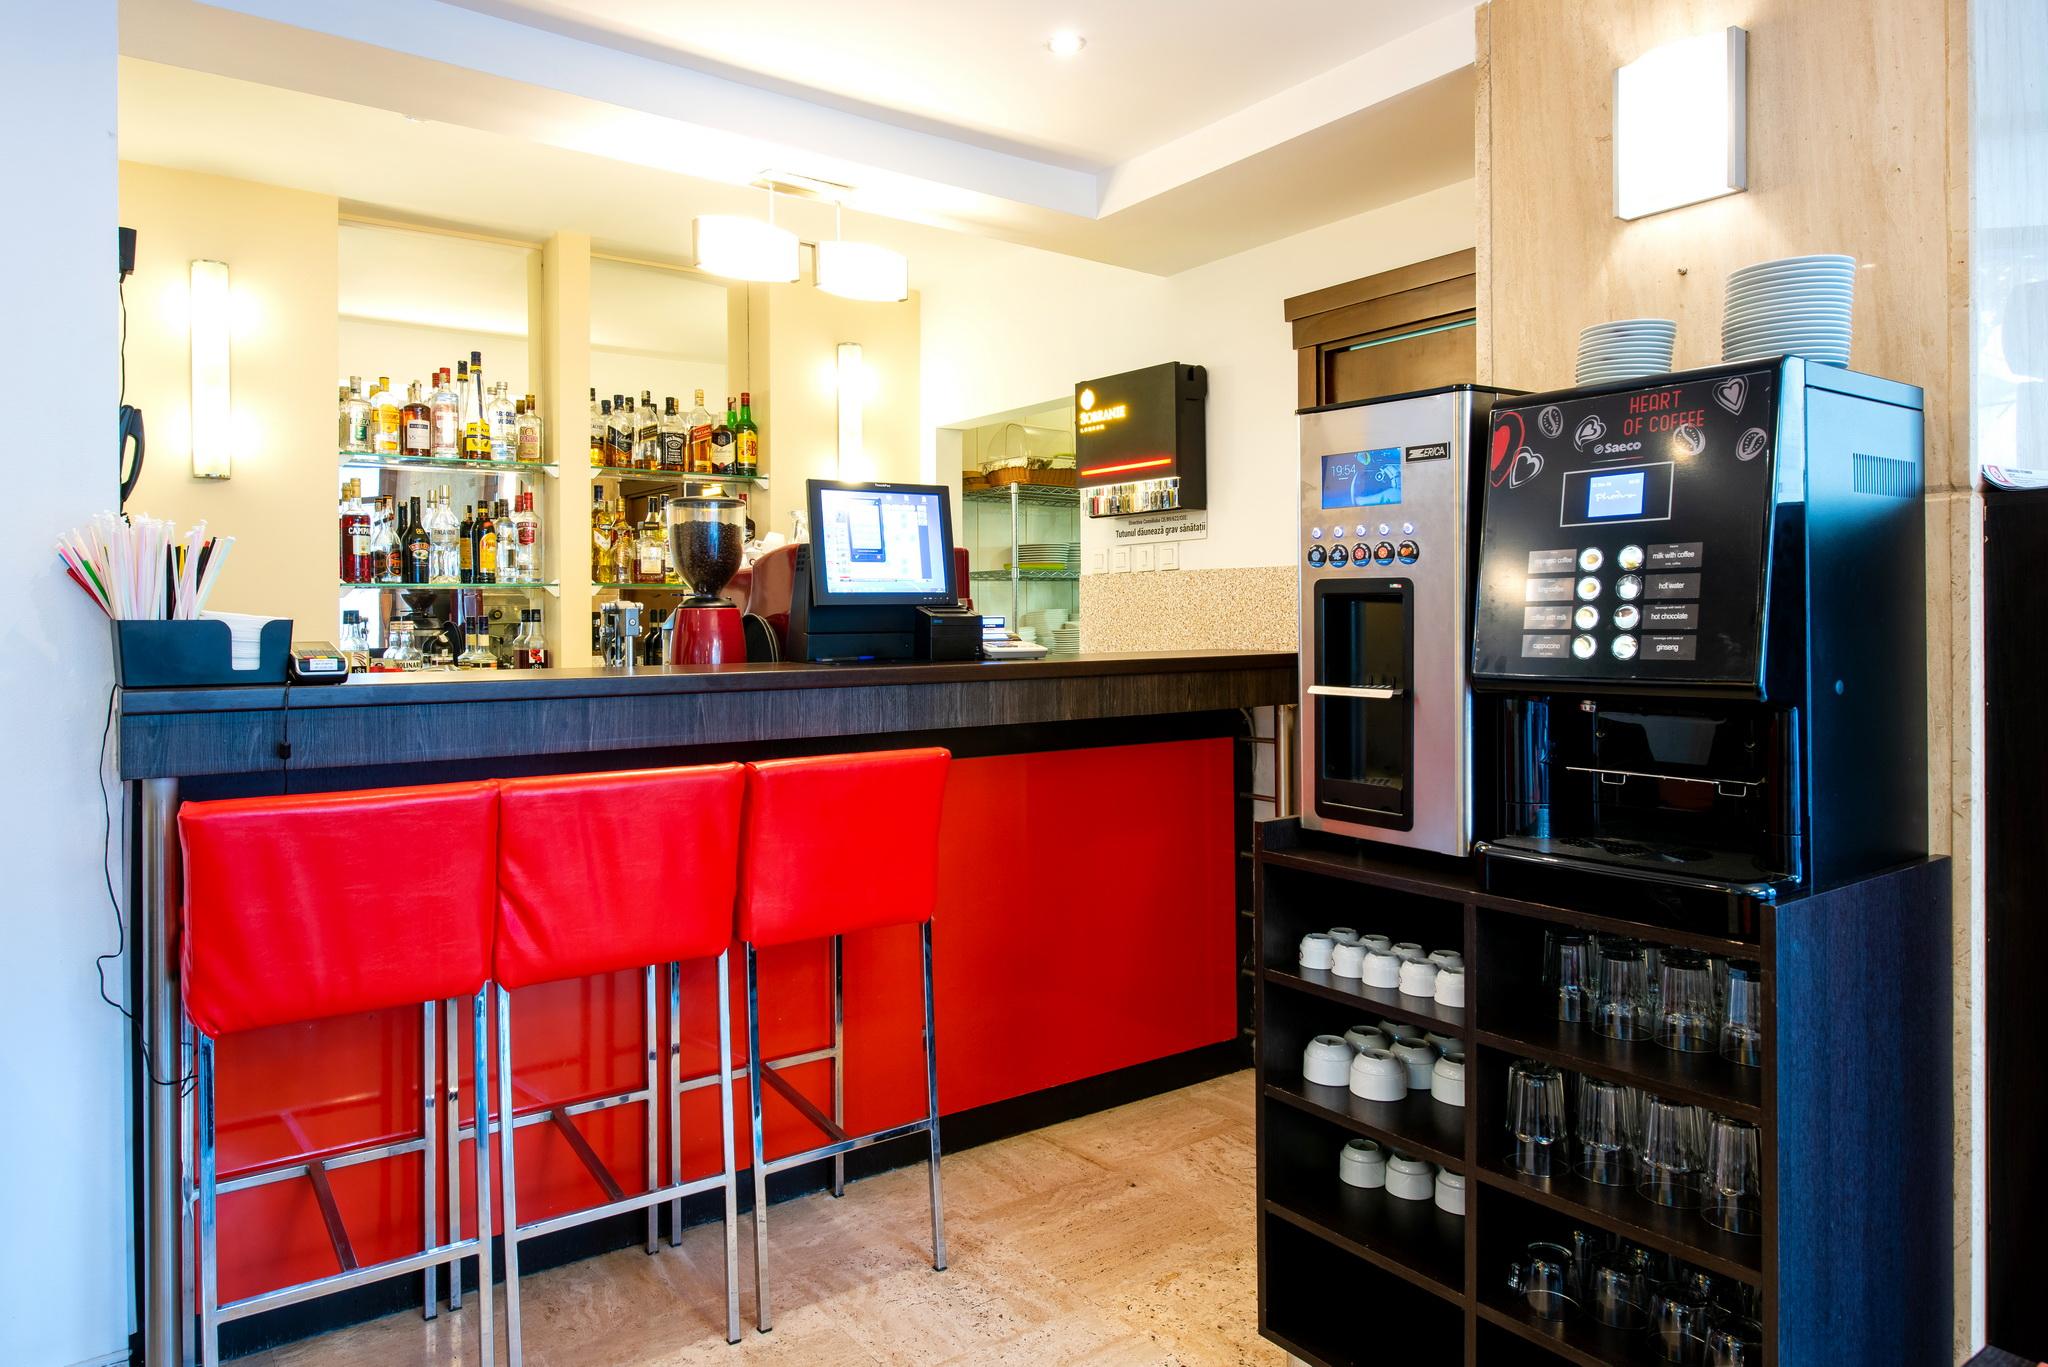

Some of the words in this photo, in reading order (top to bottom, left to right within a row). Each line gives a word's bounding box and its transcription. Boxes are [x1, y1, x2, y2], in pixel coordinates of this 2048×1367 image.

[1629, 390, 1682, 414] HEART
[1623, 417, 1643, 436] OF
[1649, 409, 1705, 432] COFFEE
[1408, 446, 1446, 459] ZERICA
[1604, 441, 1642, 453] Saeco
[1115, 528, 1136, 538] Tutunul
[1165, 525, 1178, 536] grav
[1665, 551, 1676, 559] with
[1677, 550, 1695, 558] coffee
[1658, 582, 1668, 590] hot
[1651, 612, 1660, 620] hot
[1661, 612, 1688, 620] chocolate
[1656, 644, 1679, 652] ginseng
